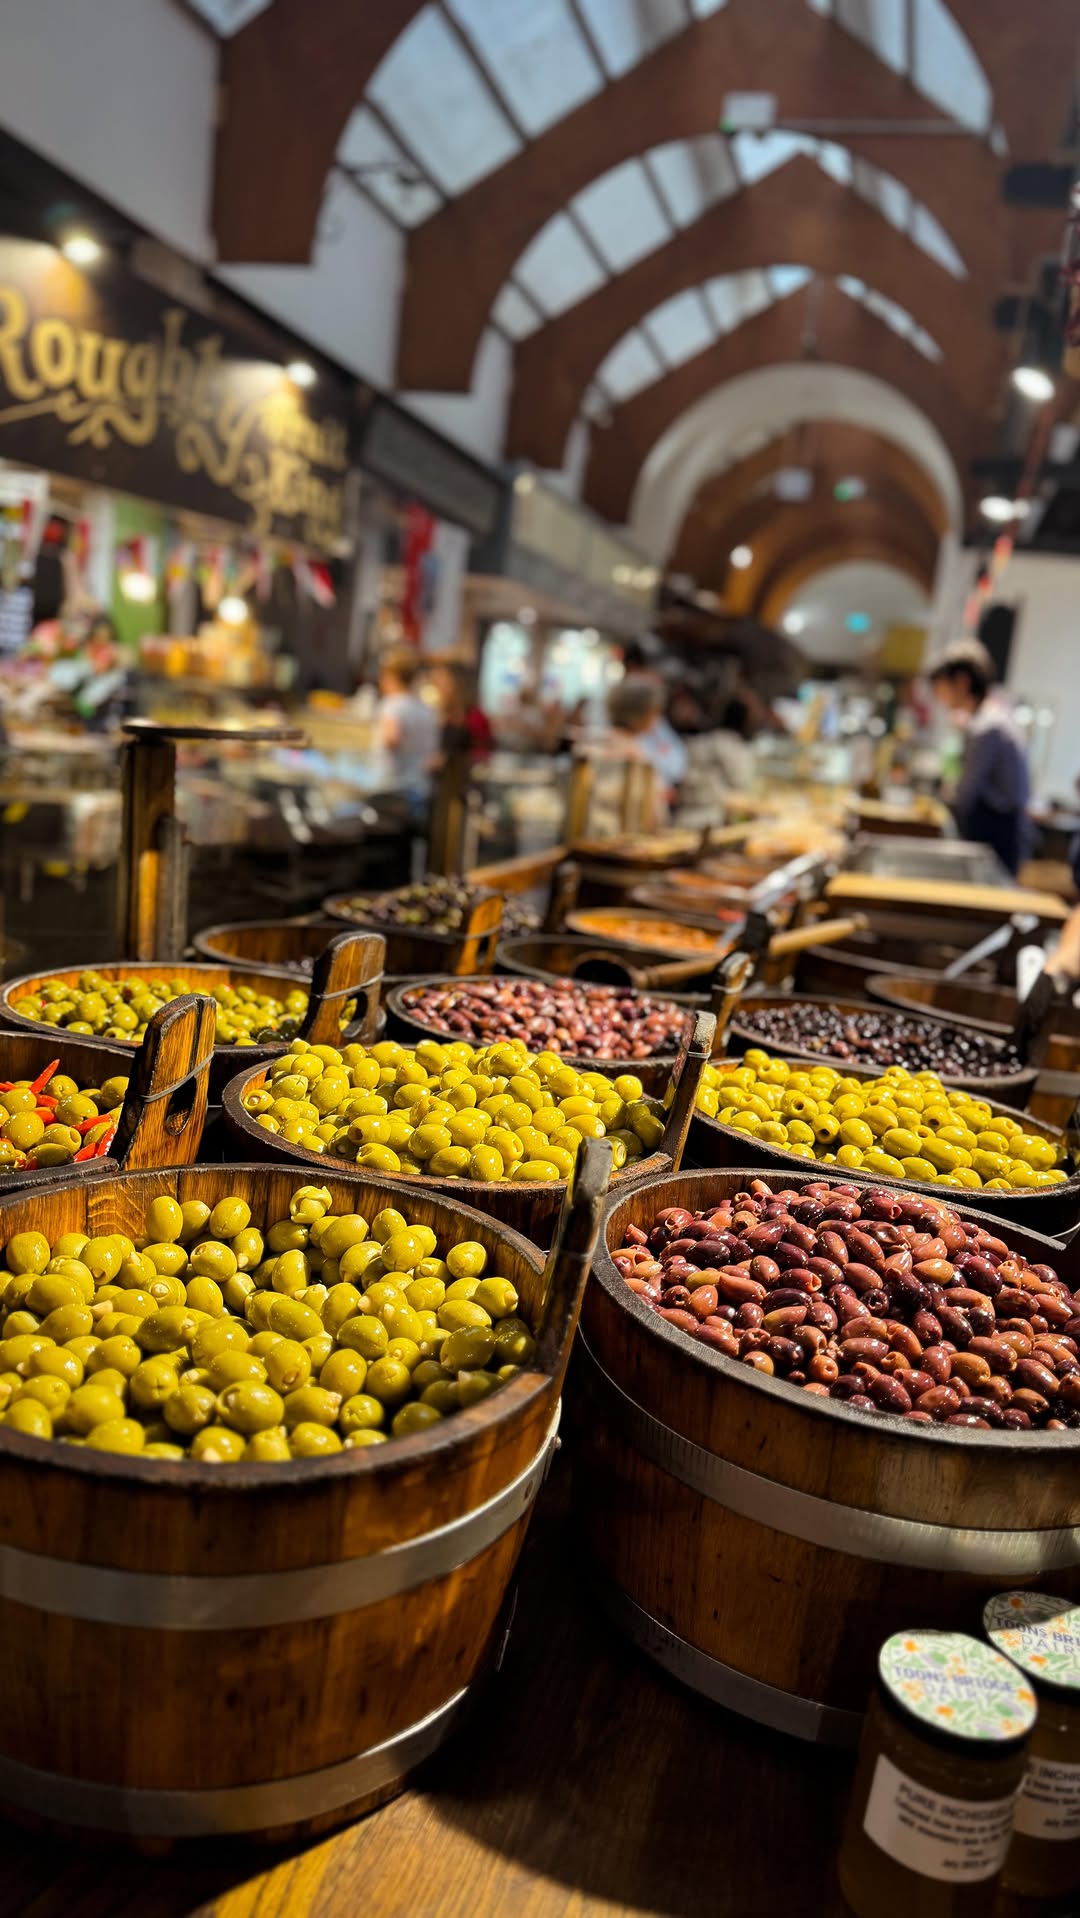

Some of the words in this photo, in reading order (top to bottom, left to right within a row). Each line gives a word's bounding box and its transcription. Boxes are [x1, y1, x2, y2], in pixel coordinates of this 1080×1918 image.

[995, 1617, 1049, 1639] TOONS
[895, 1666, 948, 1683] TOONS
[899, 1783, 937, 1811] PURE
